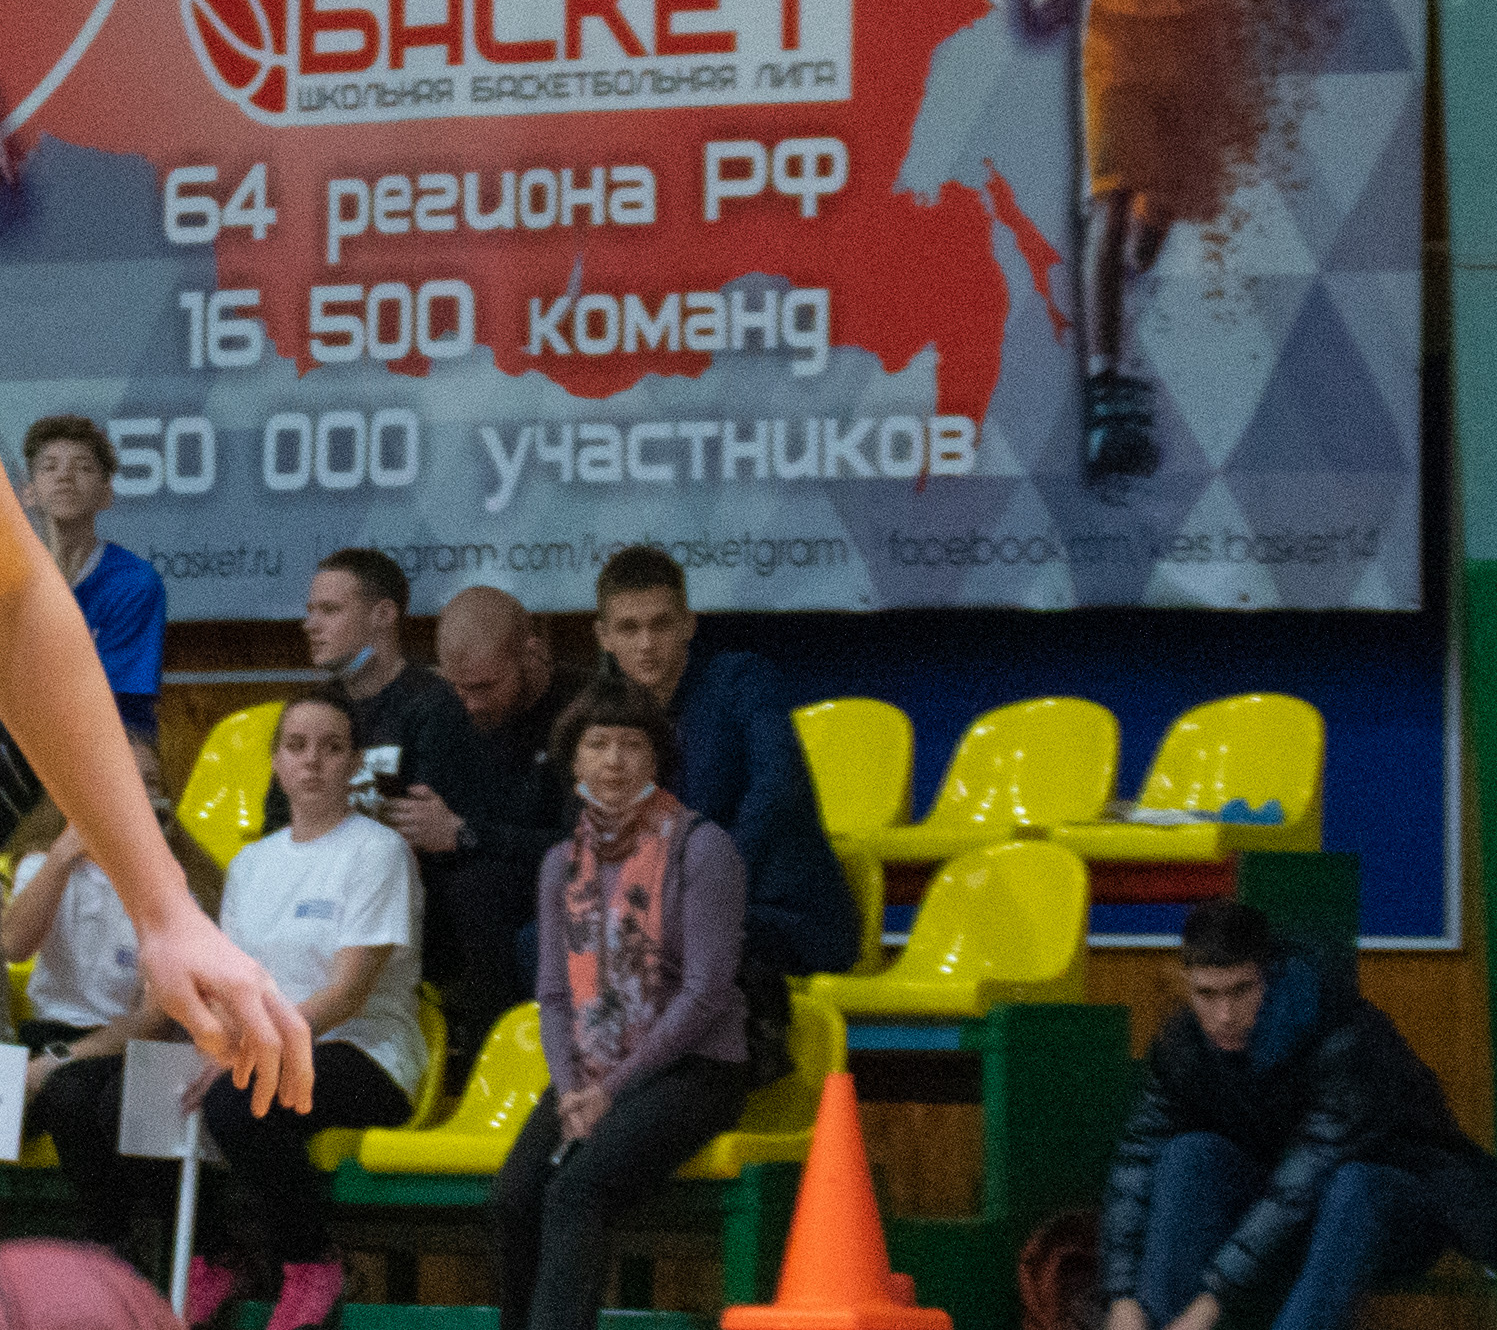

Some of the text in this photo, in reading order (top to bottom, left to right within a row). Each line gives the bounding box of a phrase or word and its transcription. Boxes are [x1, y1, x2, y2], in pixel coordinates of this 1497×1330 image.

[296, 60, 837, 113] ШКОЛЬНАЯ БАСКЕТБОЛЬНАЯ ЛИГА
[163, 136, 850, 265] 64 региона РФ
[178, 278, 831, 376] 16 500 команд
[263, 408, 420, 492] 000
[481, 413, 980, 514] участников
